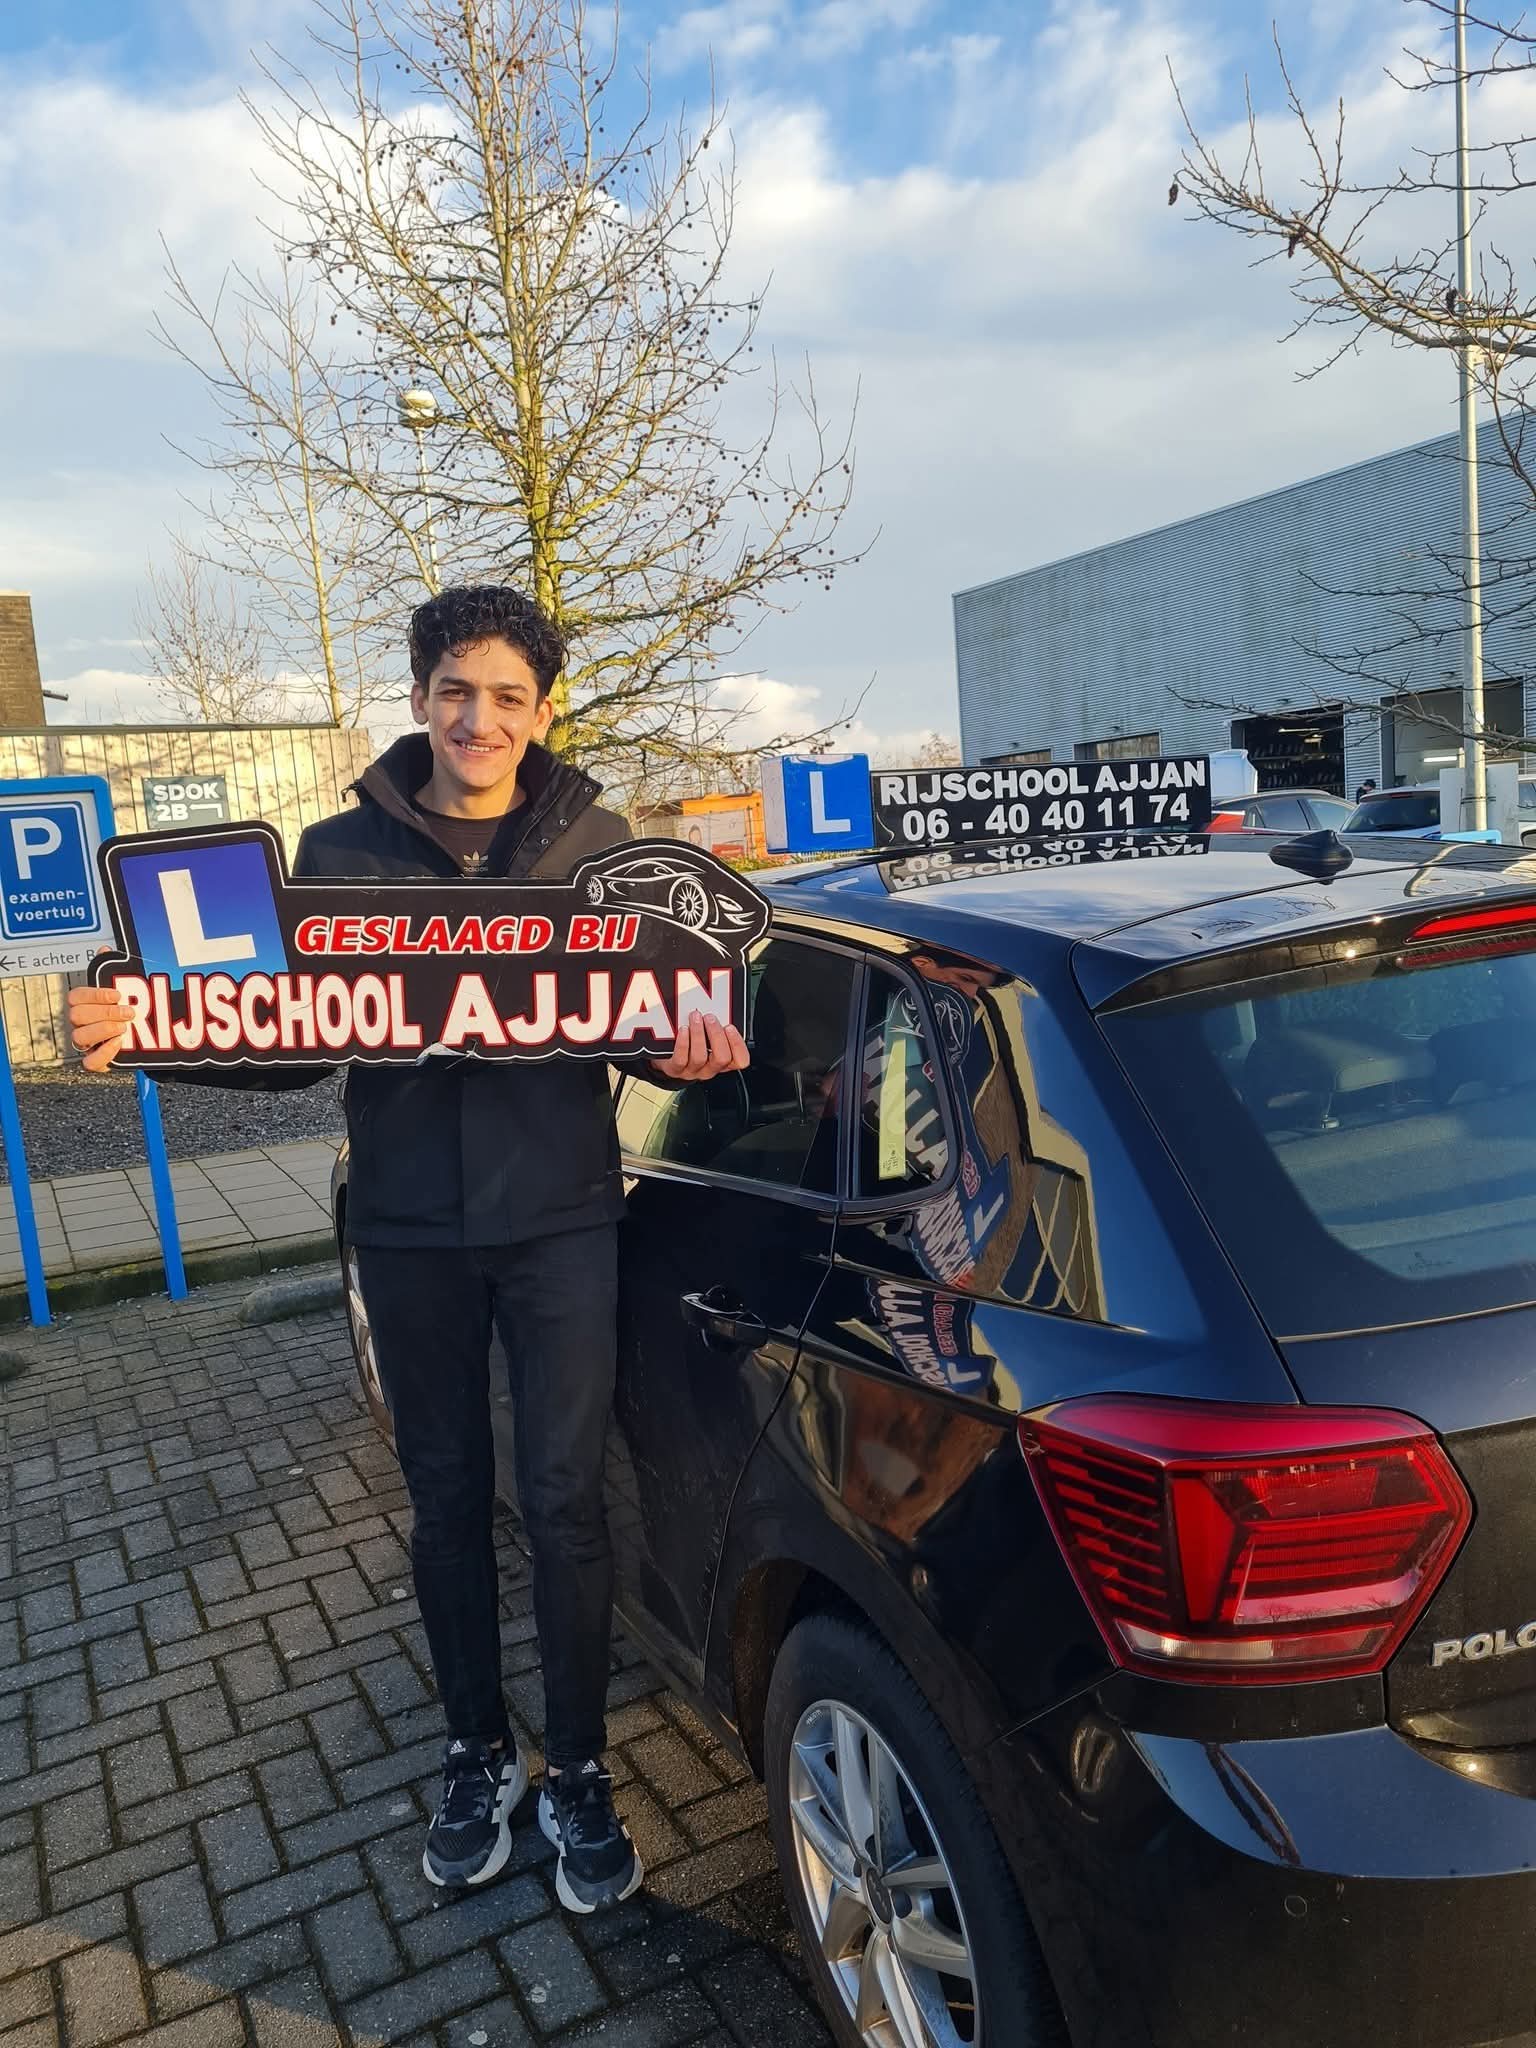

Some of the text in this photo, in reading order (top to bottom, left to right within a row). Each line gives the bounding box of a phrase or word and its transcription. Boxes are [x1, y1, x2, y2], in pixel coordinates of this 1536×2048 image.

[152, 782, 221, 802] SDOK
[808, 770, 851, 834] L
[880, 760, 1206, 806] RIJSCHOOL AJJAN
[155, 803, 189, 822] 2B
[902, 807, 950, 842] 06
[985, 803, 1030, 835] 40
[1042, 799, 1085, 831] 40
[1097, 797, 1135, 827] 11
[1149, 793, 1190, 823] 74
[10, 816, 62, 880] P
[9, 888, 85, 905] examen-
[14, 905, 86, 922] voertuig
[157, 868, 257, 968] L
[295, 914, 642, 955] GESLAAGD BIJ
[18, 956, 28, 968] E
[33, 952, 81, 967] achter
[113, 967, 733, 1051] RIJSCHOOL AJJAN
[1432, 1620, 1536, 1667] POLO
